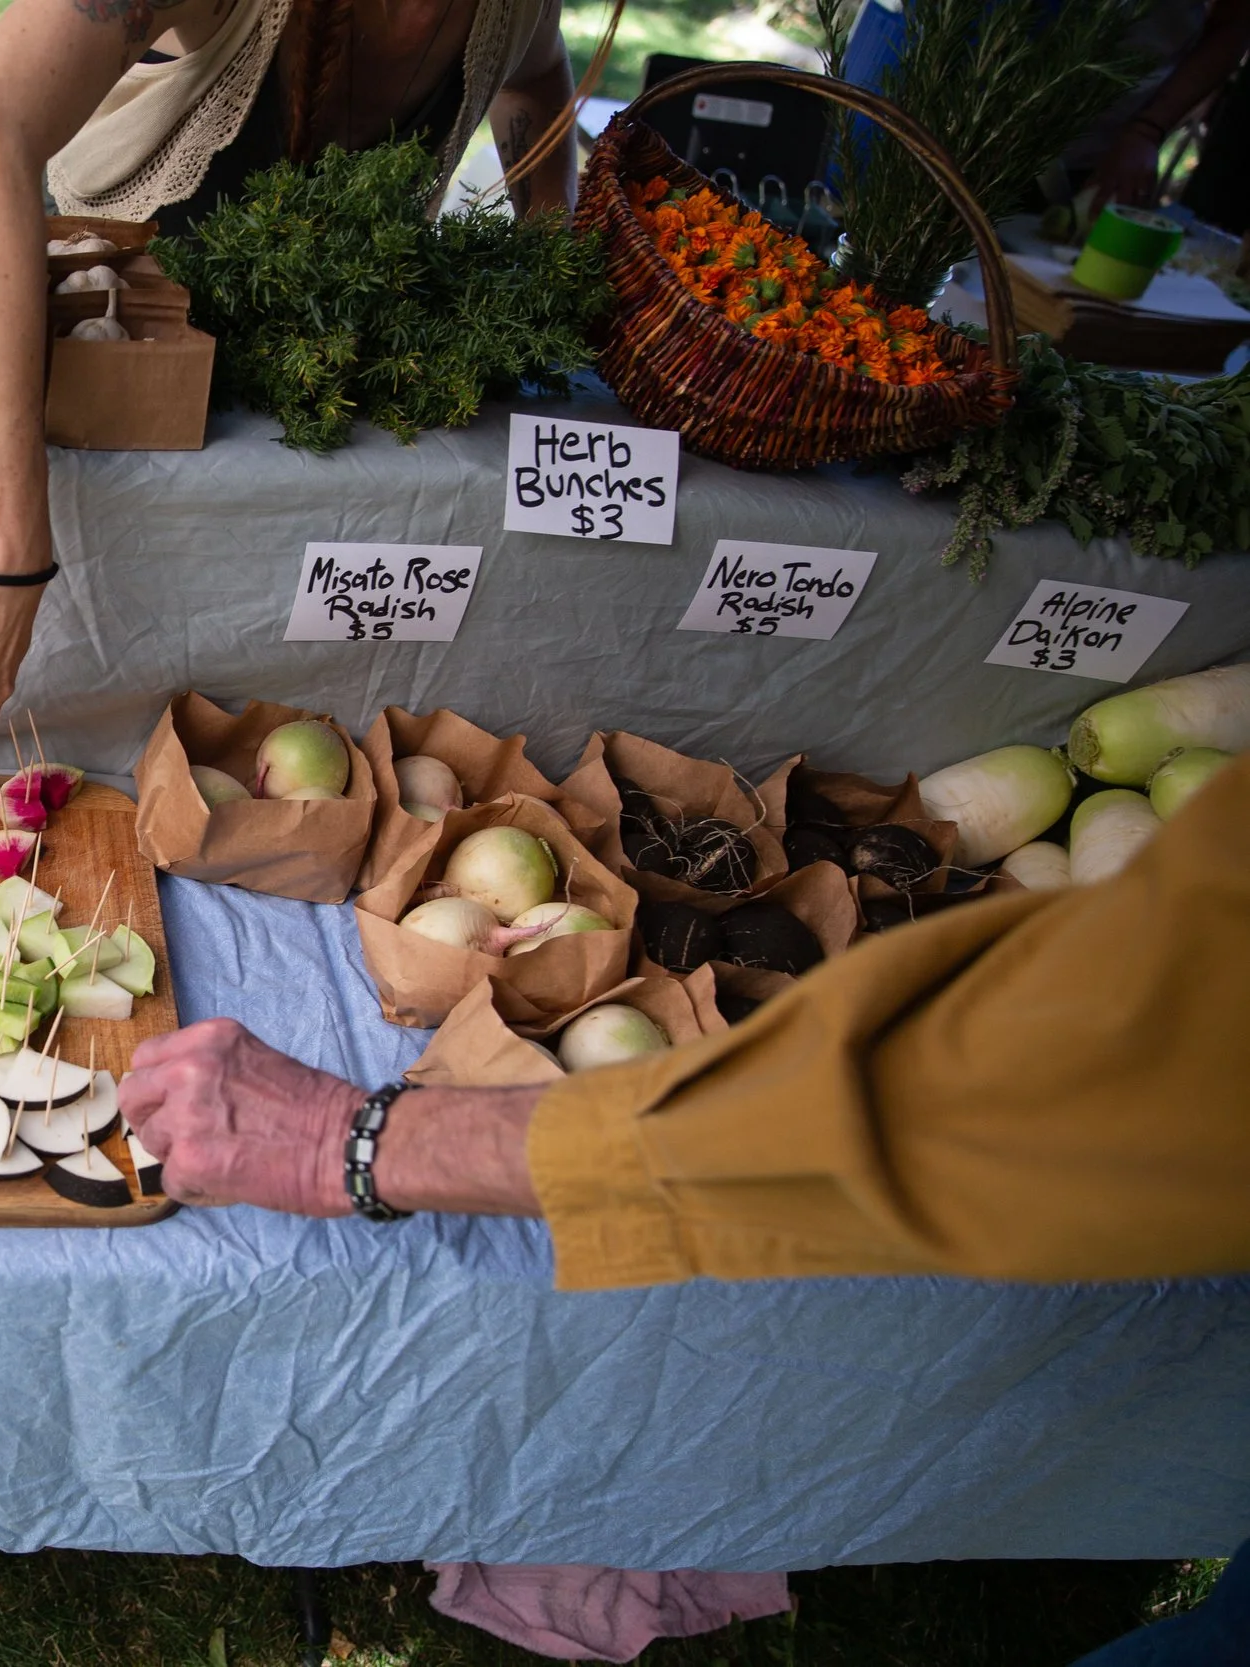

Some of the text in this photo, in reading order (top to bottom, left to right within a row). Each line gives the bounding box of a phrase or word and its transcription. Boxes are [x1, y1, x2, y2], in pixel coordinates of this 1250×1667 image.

[535, 424, 631, 468] Herb
[515, 467, 666, 508] Bunches
[571, 504, 623, 539] $3
[307, 557, 471, 594] Misato Rose
[707, 555, 854, 598] Nero Tondo
[324, 594, 436, 621] Radish
[716, 592, 814, 619] Radish
[1039, 592, 1138, 630] Alpine
[346, 620, 395, 641] $5
[730, 616, 781, 636] $5
[1007, 620, 1123, 651] Daikon
[1030, 648, 1077, 670] $3
